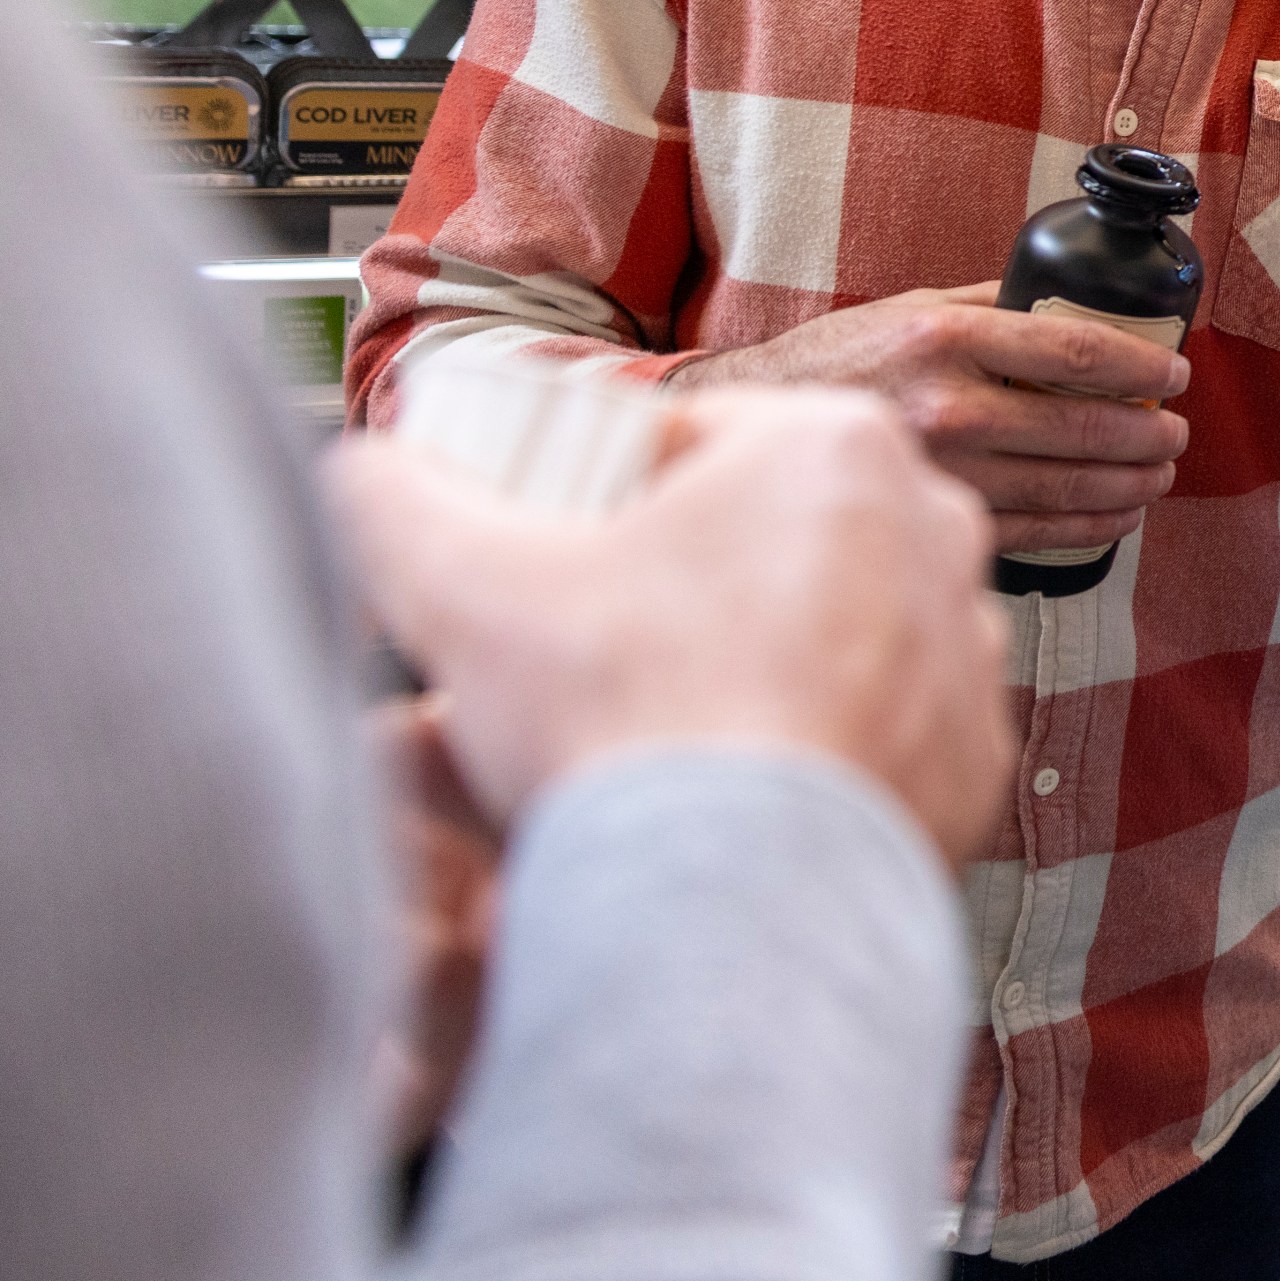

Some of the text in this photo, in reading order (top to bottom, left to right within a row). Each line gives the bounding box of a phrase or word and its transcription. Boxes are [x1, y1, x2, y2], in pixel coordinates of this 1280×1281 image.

[137, 105, 190, 121] IVER
[295, 106, 417, 125] COD LIVER
[366, 145, 418, 165] MINN
